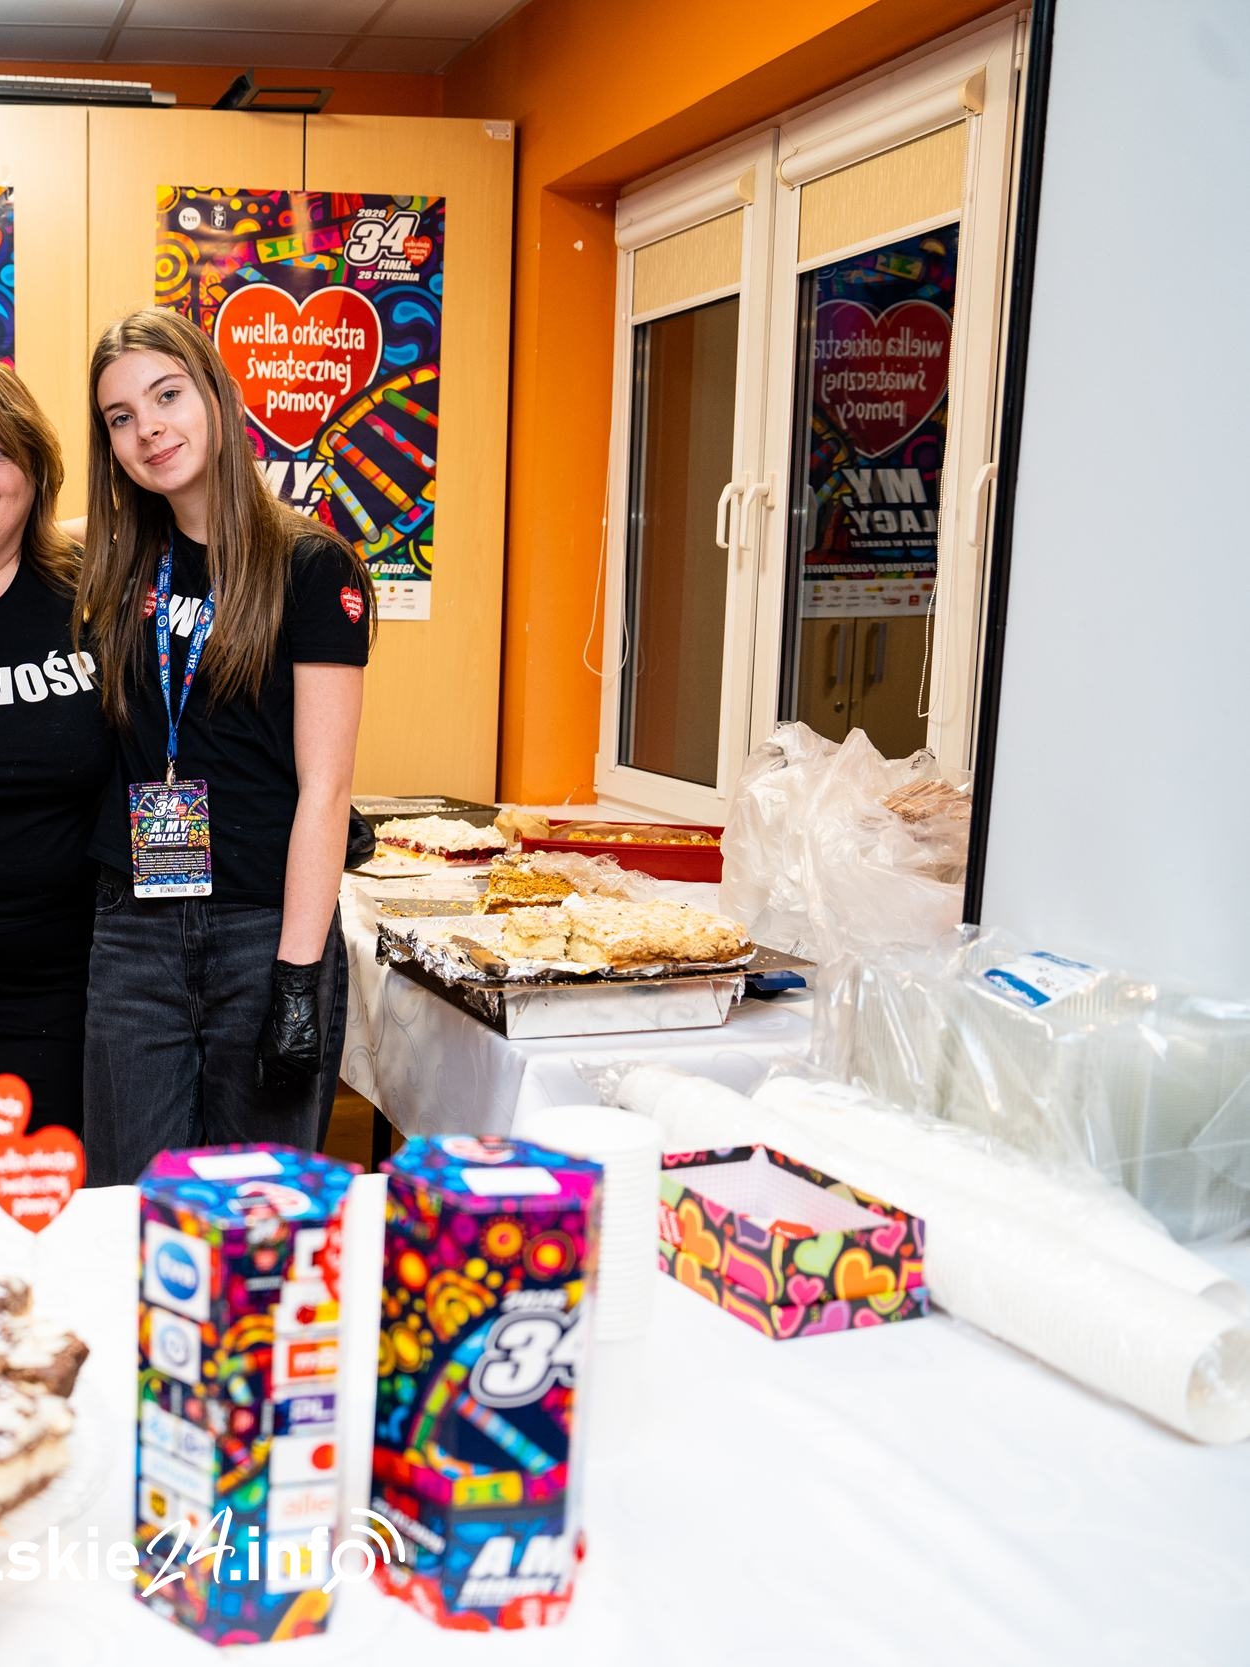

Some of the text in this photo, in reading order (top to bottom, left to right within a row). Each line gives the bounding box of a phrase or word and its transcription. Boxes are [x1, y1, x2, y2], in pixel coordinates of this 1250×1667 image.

[357, 208, 386, 218] 2026
[345, 212, 419, 264] 34
[358, 271, 420, 281] 25 STYCZNIA
[231, 313, 365, 349] wielka orkiestra
[246, 350, 351, 395] świątecznej
[266, 388, 335, 422] pomocy
[380, 563, 415, 573] DZIECI
[187, 653, 197, 669] 112
[153, 795, 181, 818] 34
[150, 822, 160, 833] A
